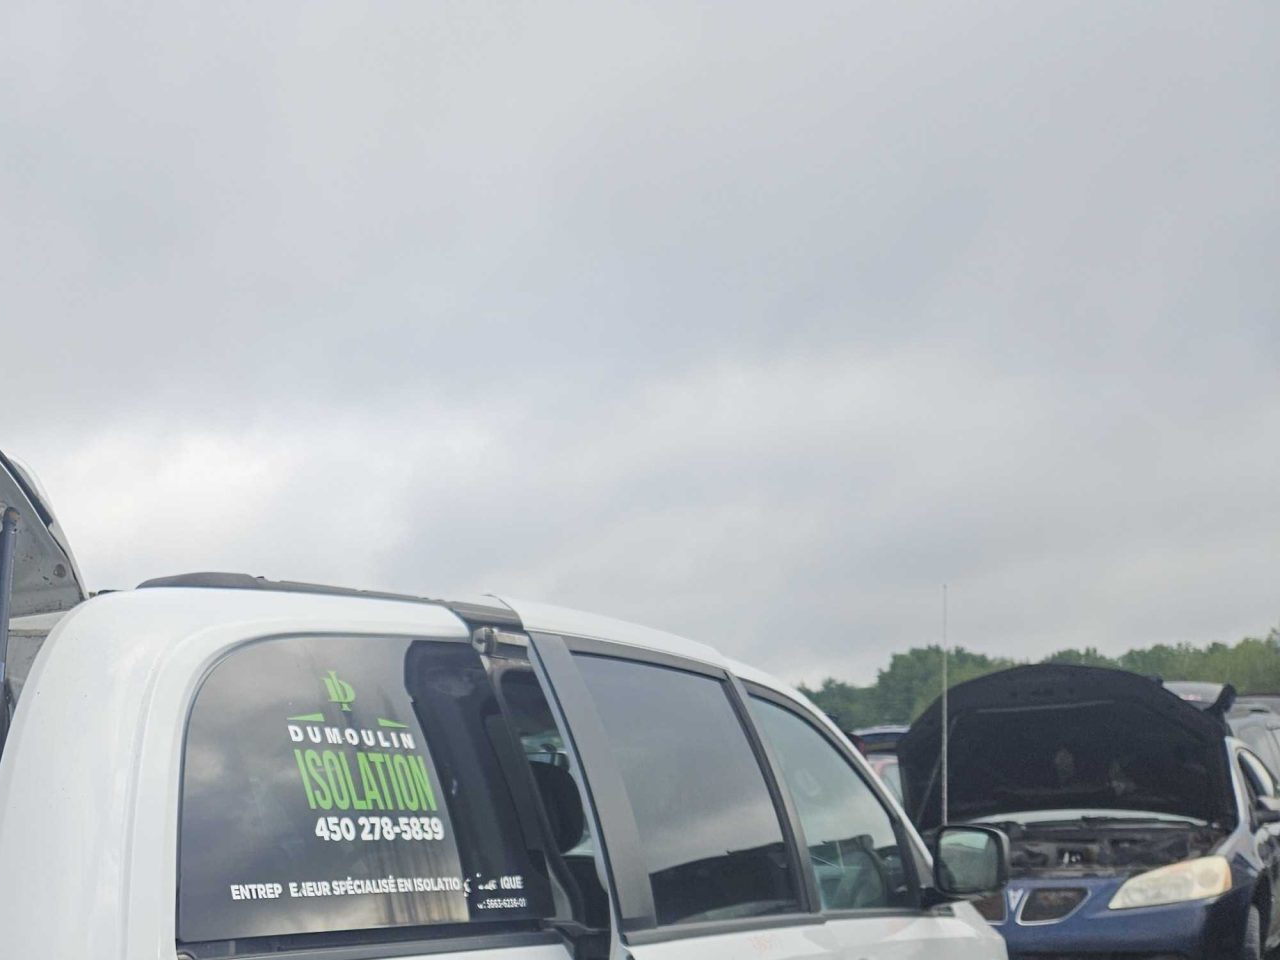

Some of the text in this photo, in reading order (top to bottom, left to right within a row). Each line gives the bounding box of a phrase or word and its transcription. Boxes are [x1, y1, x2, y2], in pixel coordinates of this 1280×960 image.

[287, 724, 416, 750] DUMOULIN
[294, 748, 438, 812] ISOLATION
[315, 816, 444, 842] 450 278-5839
[332, 875, 397, 896] SPÉCIALISÉ
[397, 877, 414, 893] EN
